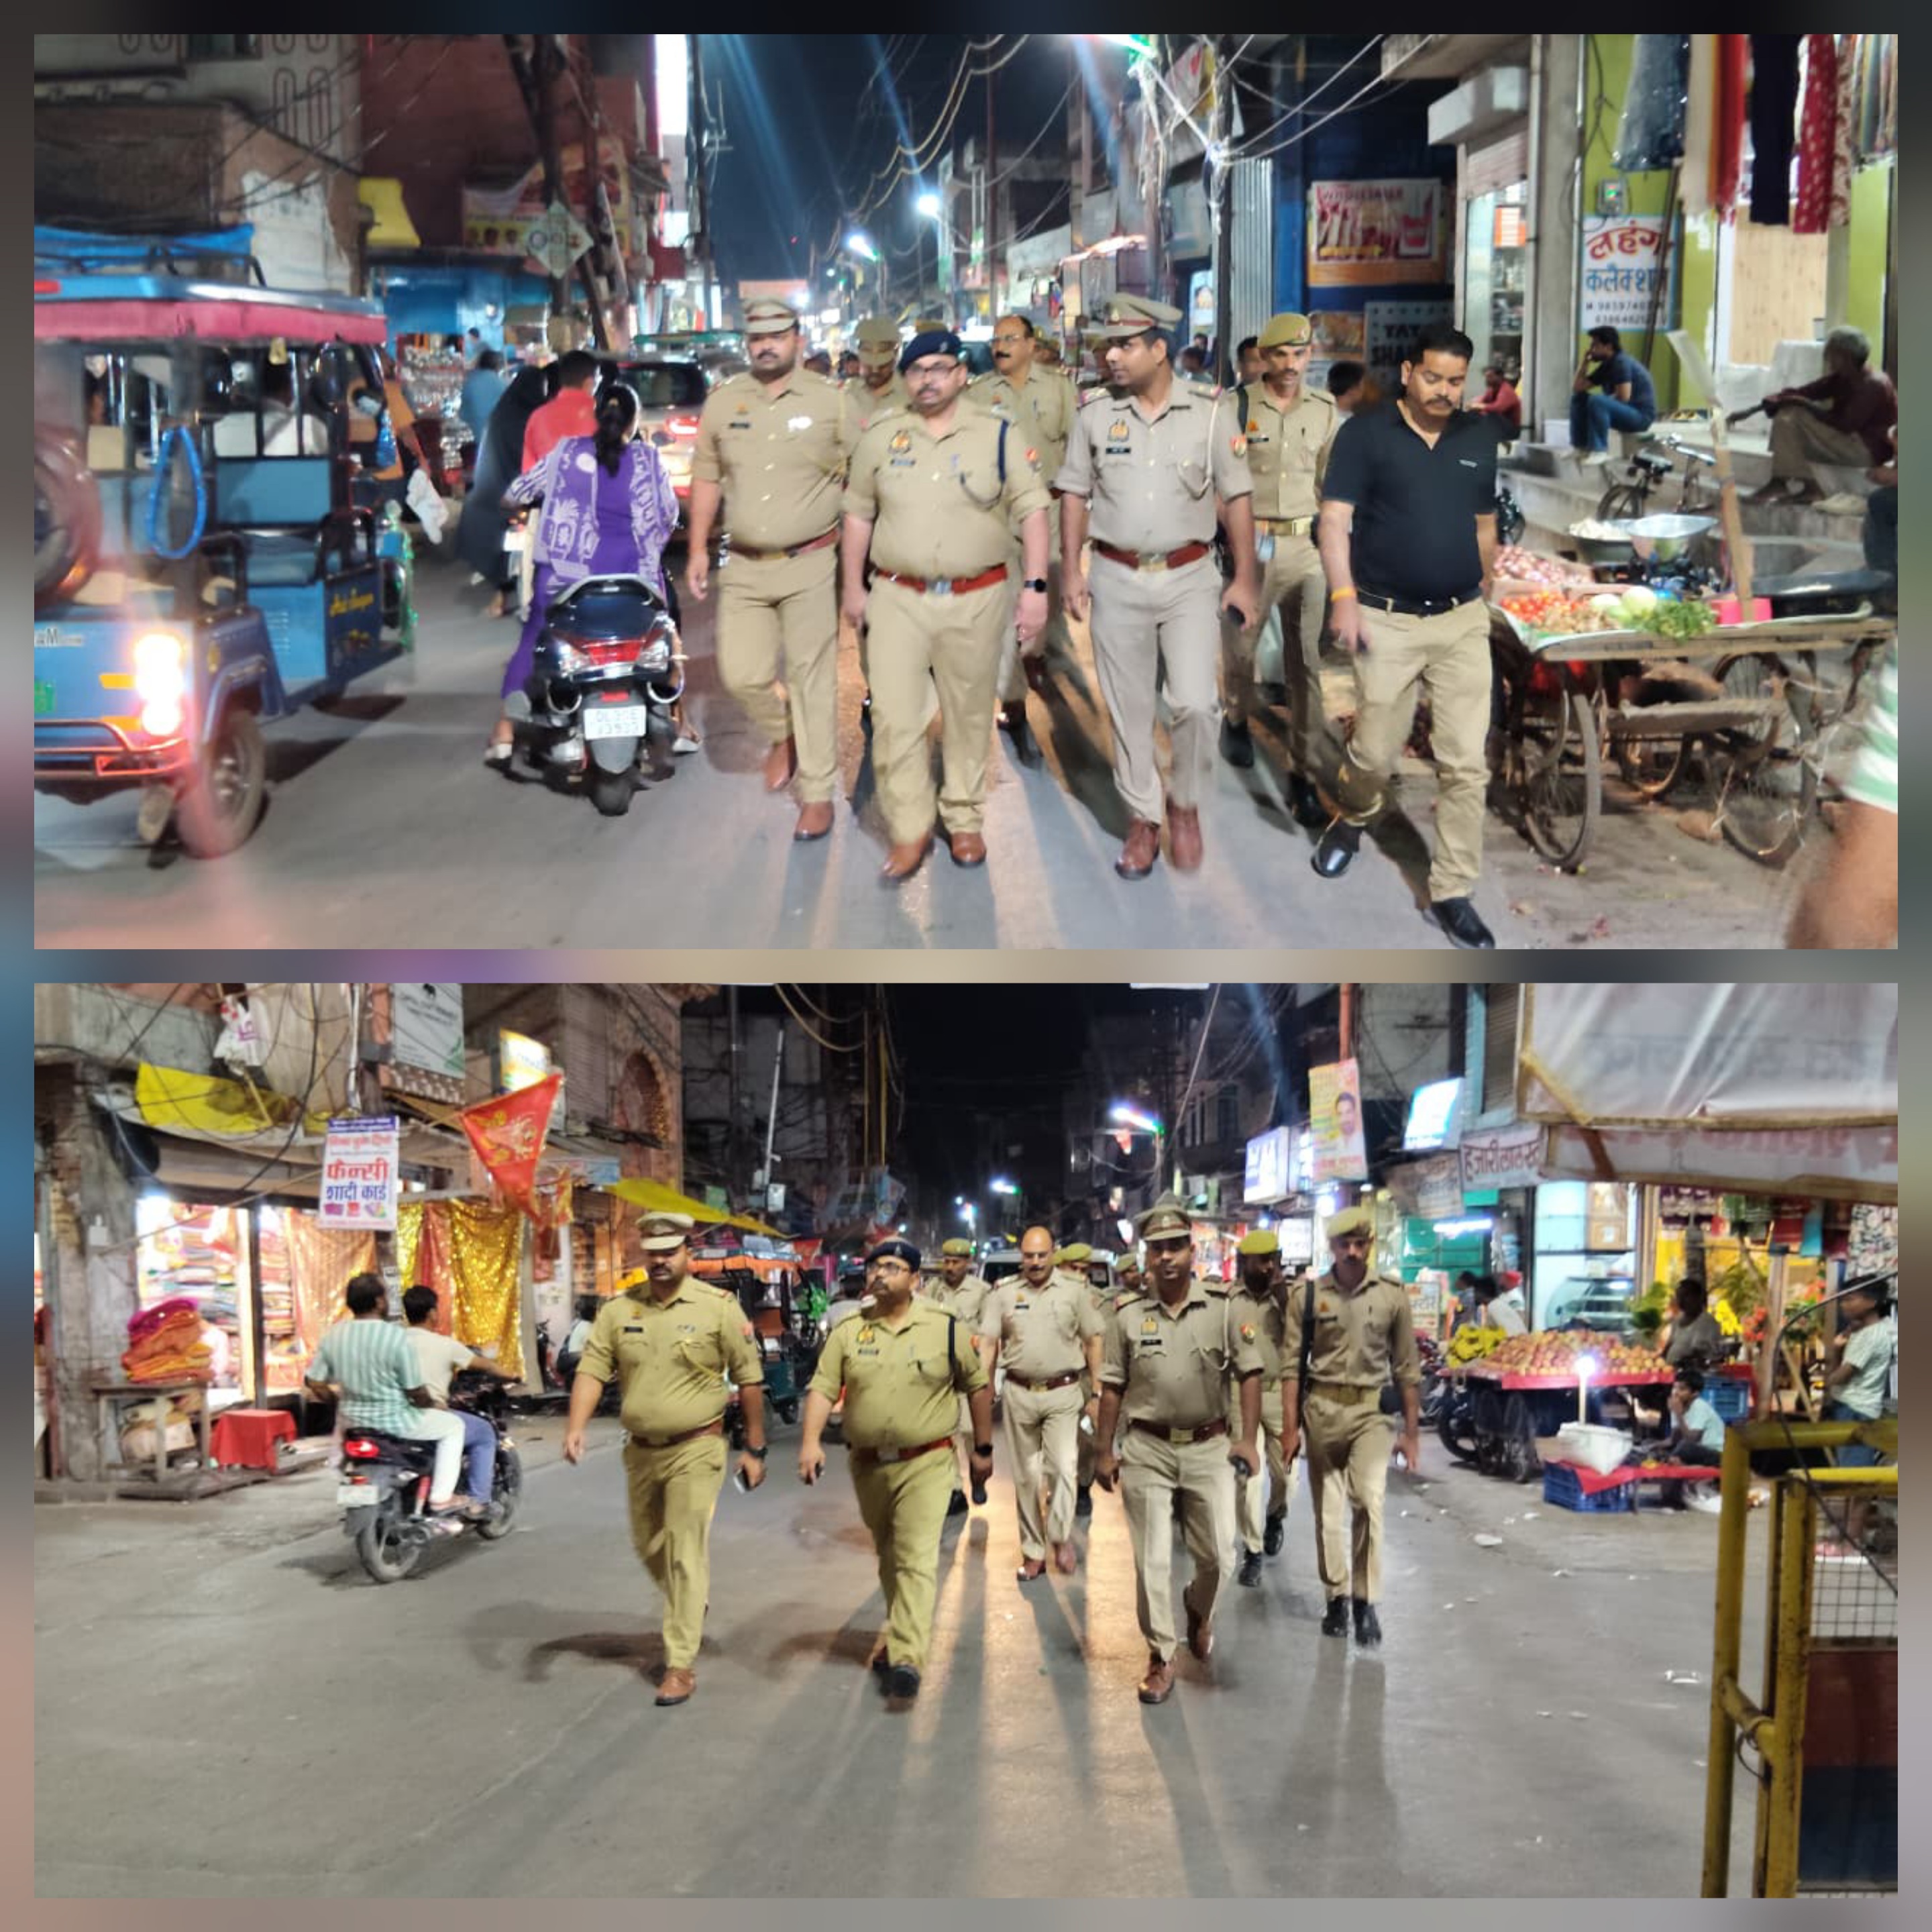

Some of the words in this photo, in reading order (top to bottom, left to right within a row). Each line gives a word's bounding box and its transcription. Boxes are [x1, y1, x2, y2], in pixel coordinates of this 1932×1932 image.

[1587, 220, 1676, 260] लहंग
[1385, 324, 1421, 338] TAT
[326, 1181, 356, 1200] शादी
